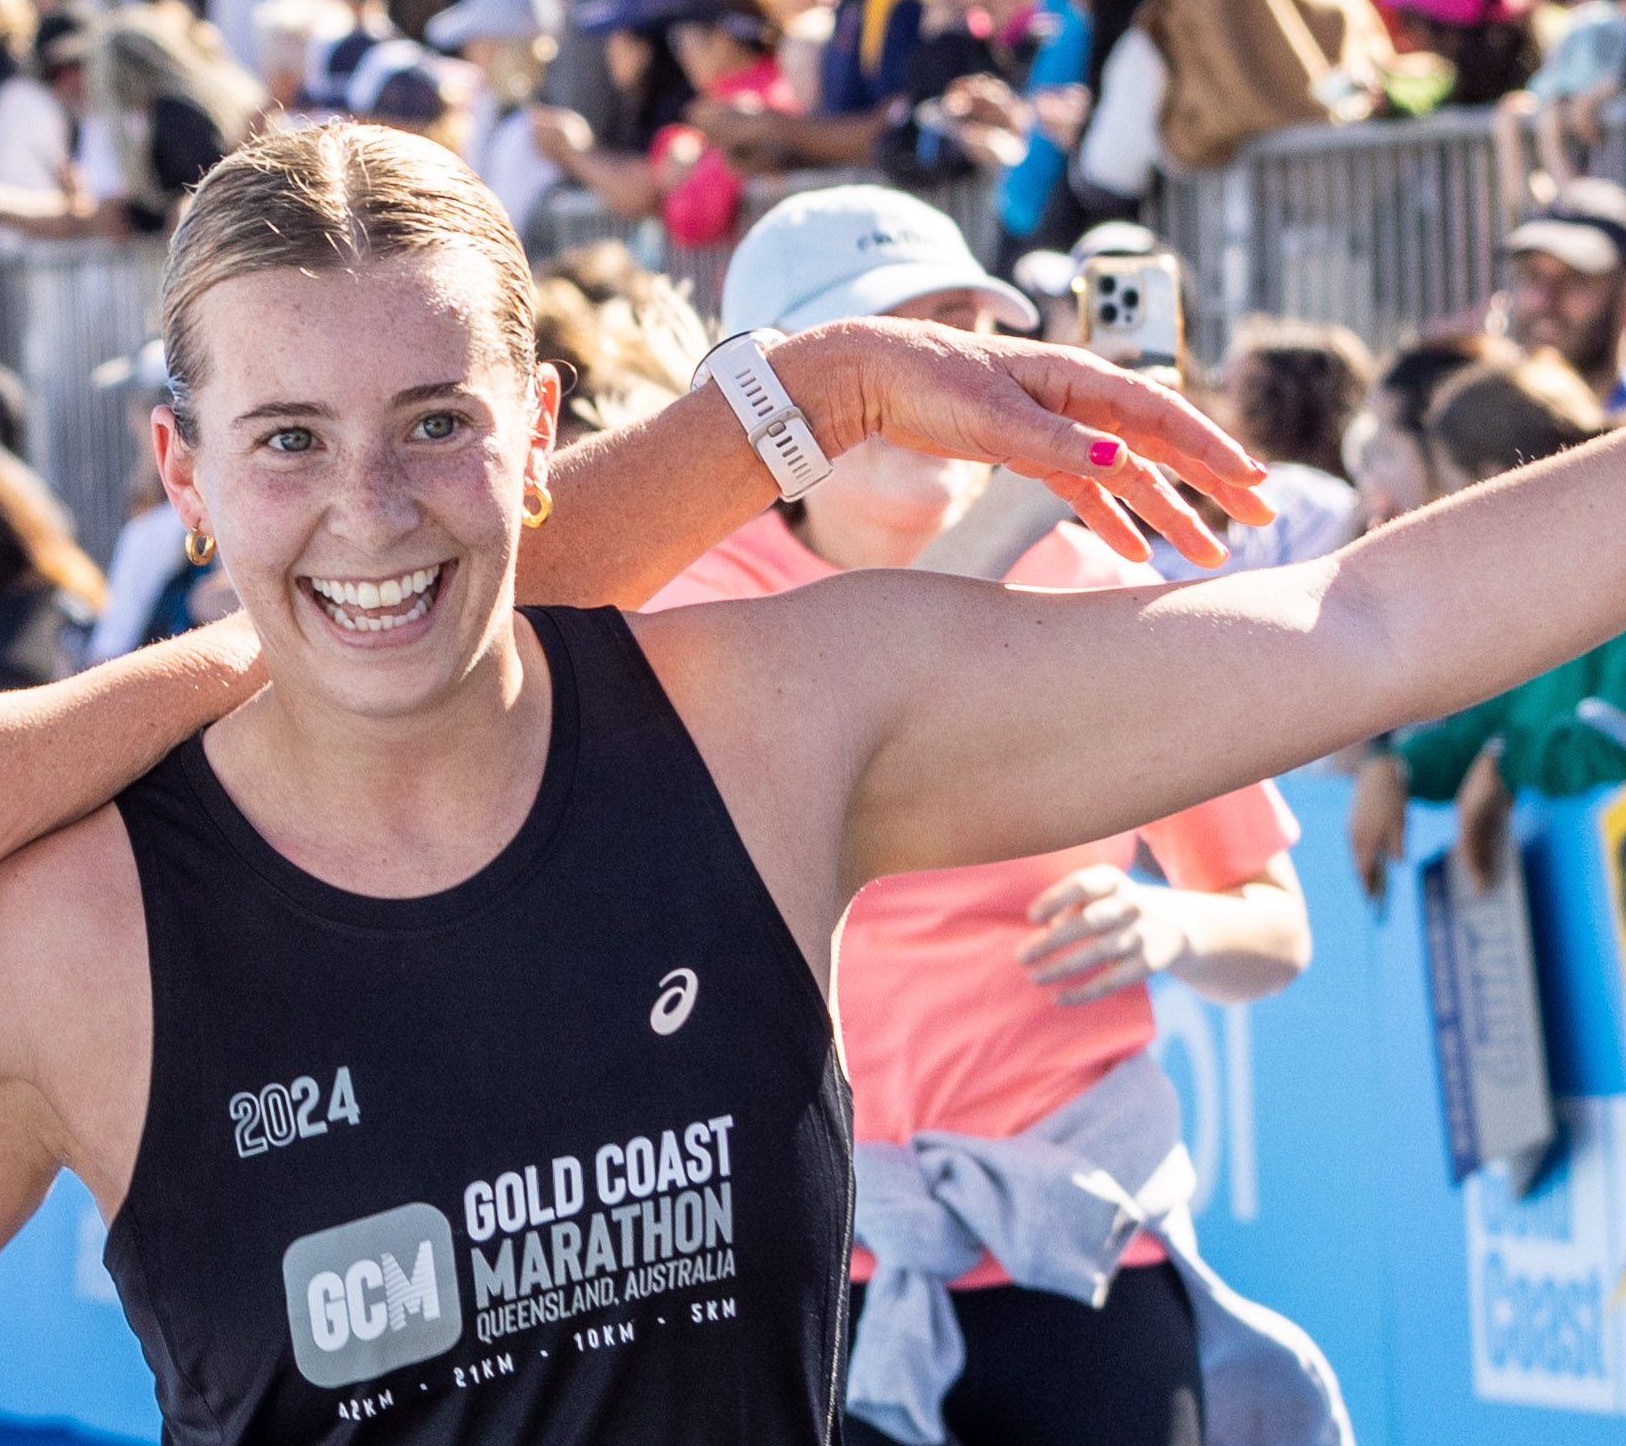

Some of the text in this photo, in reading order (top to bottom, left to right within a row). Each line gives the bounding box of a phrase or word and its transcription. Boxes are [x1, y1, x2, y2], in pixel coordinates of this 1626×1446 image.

[229, 1066, 361, 1158] 2024
[463, 1114, 734, 1241] GOLD COAST
[307, 1240, 441, 1352] GCM
[470, 1182, 732, 1310] MARATHON
[476, 1248, 736, 1344] QUEENSLAND, AUSTRALIA
[453, 1353, 514, 1387] 21KM
[574, 1323, 635, 1352] 10KM
[691, 1297, 736, 1323] 5KM
